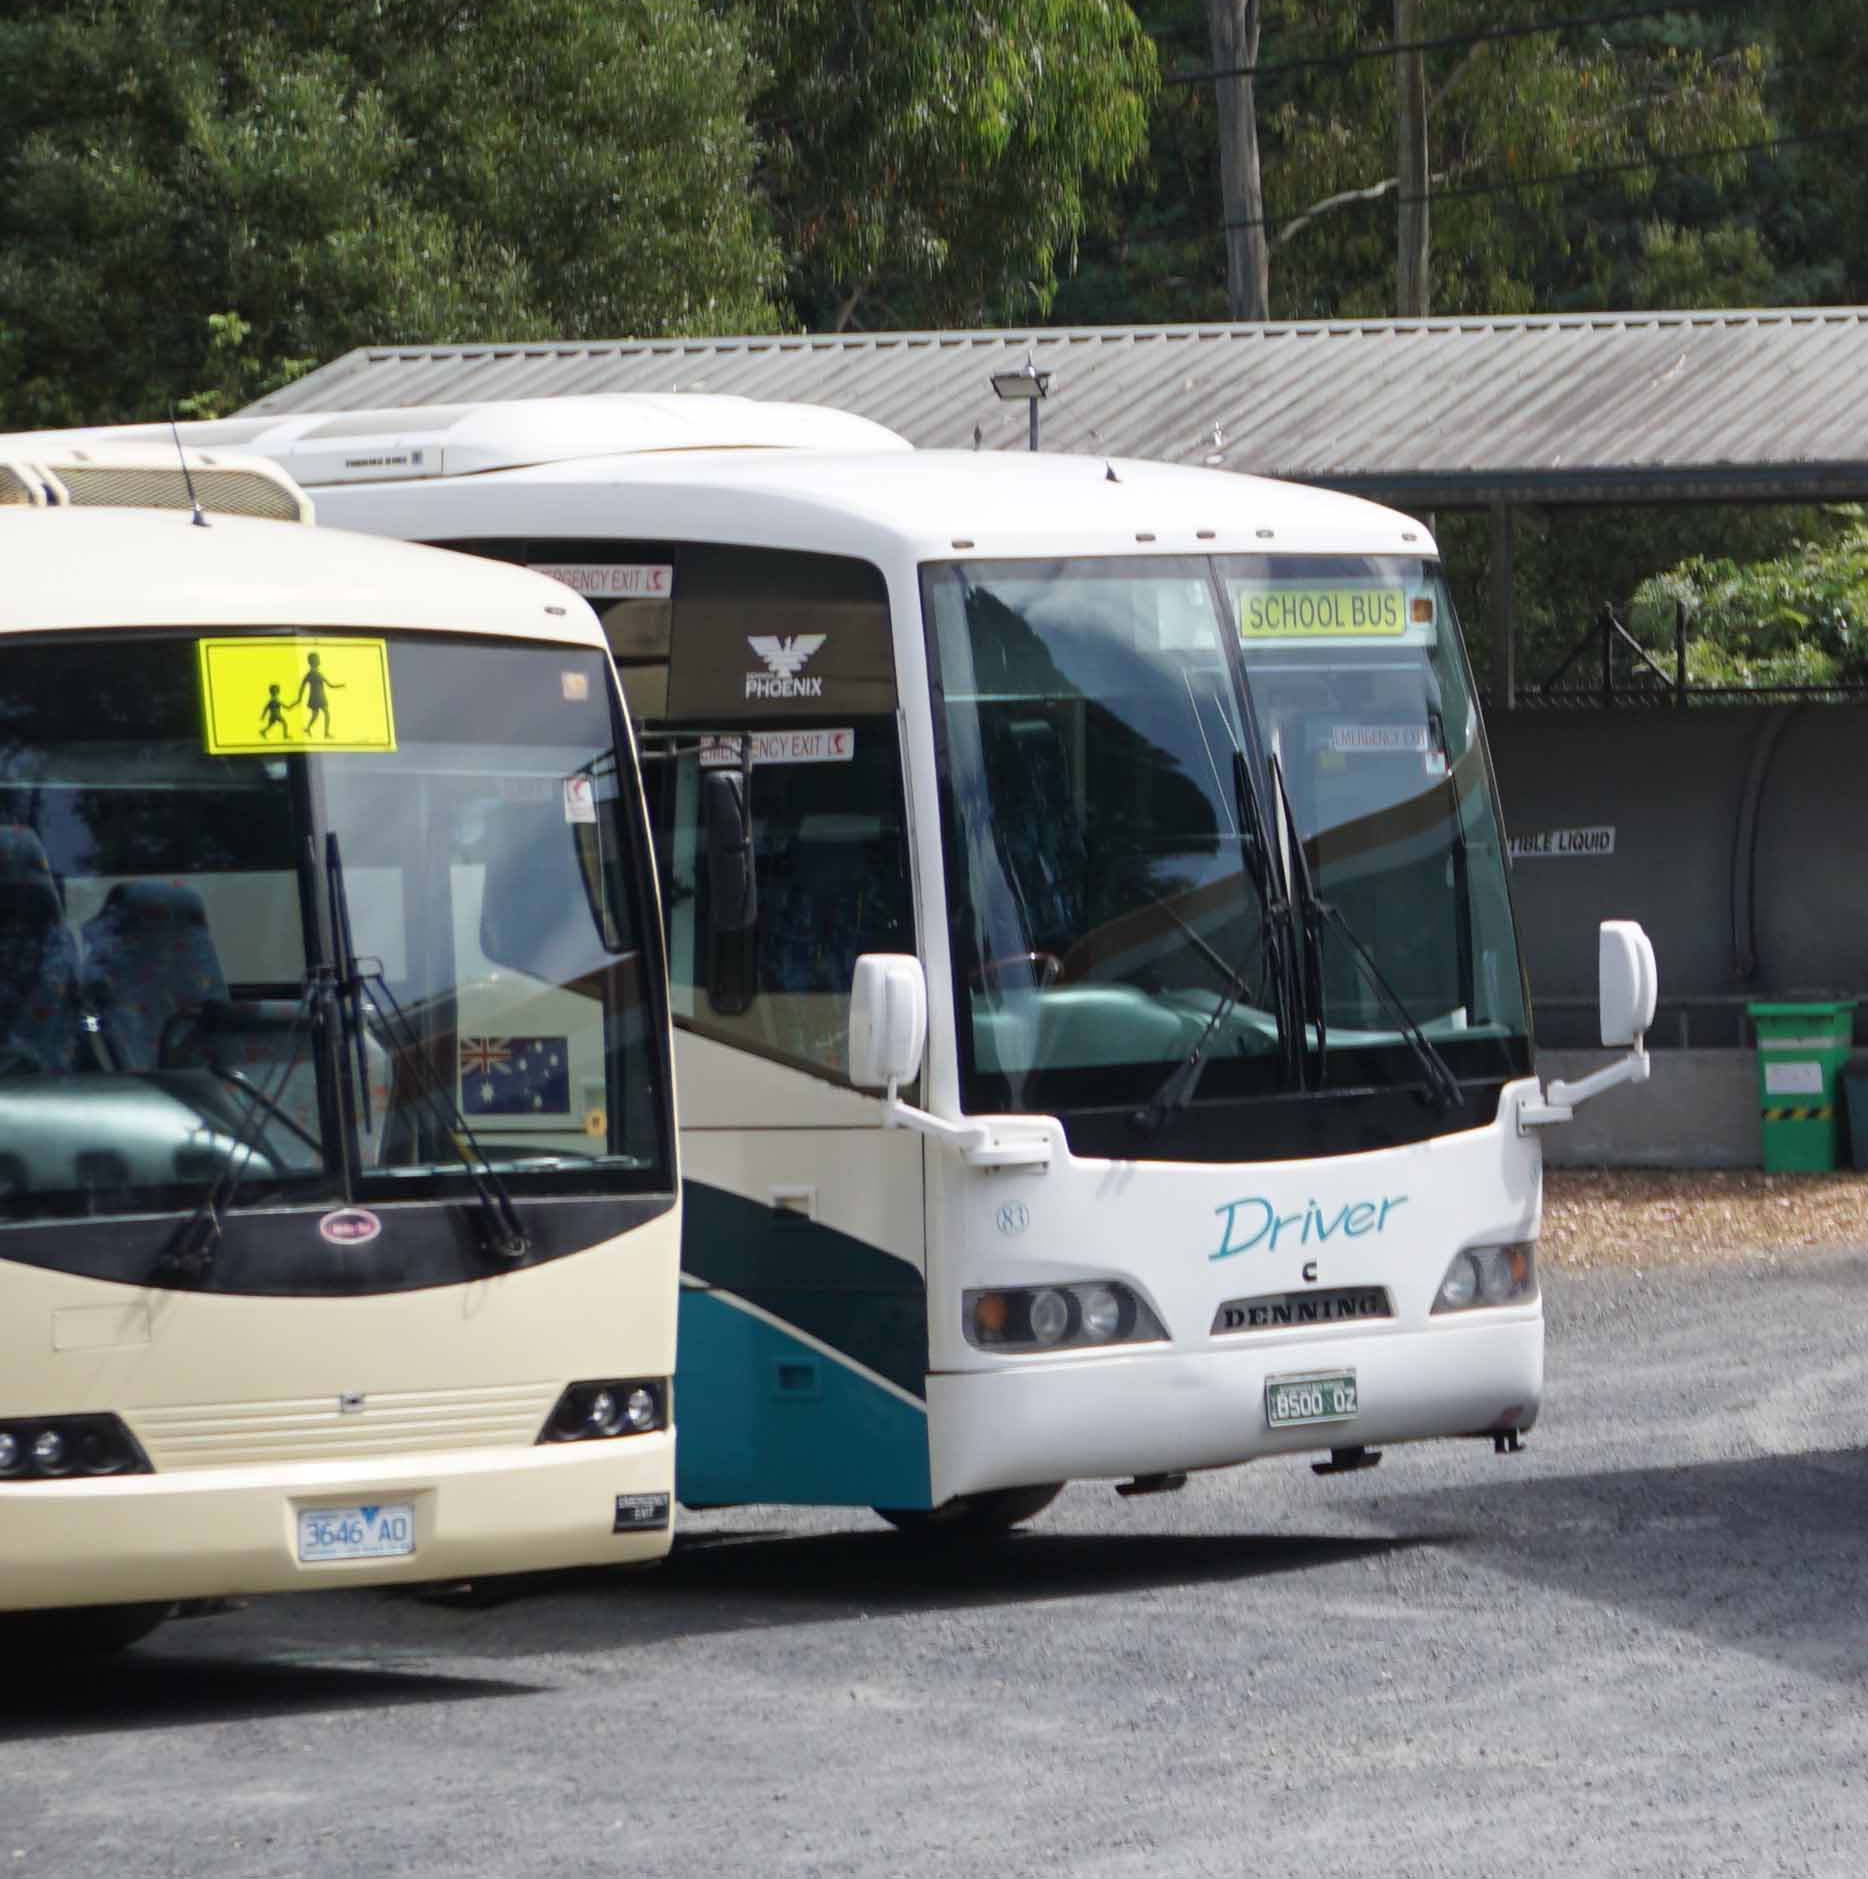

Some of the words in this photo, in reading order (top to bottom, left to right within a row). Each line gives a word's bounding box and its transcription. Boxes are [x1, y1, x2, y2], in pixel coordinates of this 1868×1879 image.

[611, 570, 641, 591] EXIT
[1250, 594, 1345, 630] SCHOOL
[1351, 594, 1397, 628] BUS
[744, 676, 823, 699] PHOENIX
[791, 733, 822, 757] EXIT
[1558, 830, 1611, 851] LIQUID
[1206, 1193, 1408, 1261] Driver
[1223, 1293, 1377, 1329] DENNING
[306, 1519, 363, 1546] 3646
